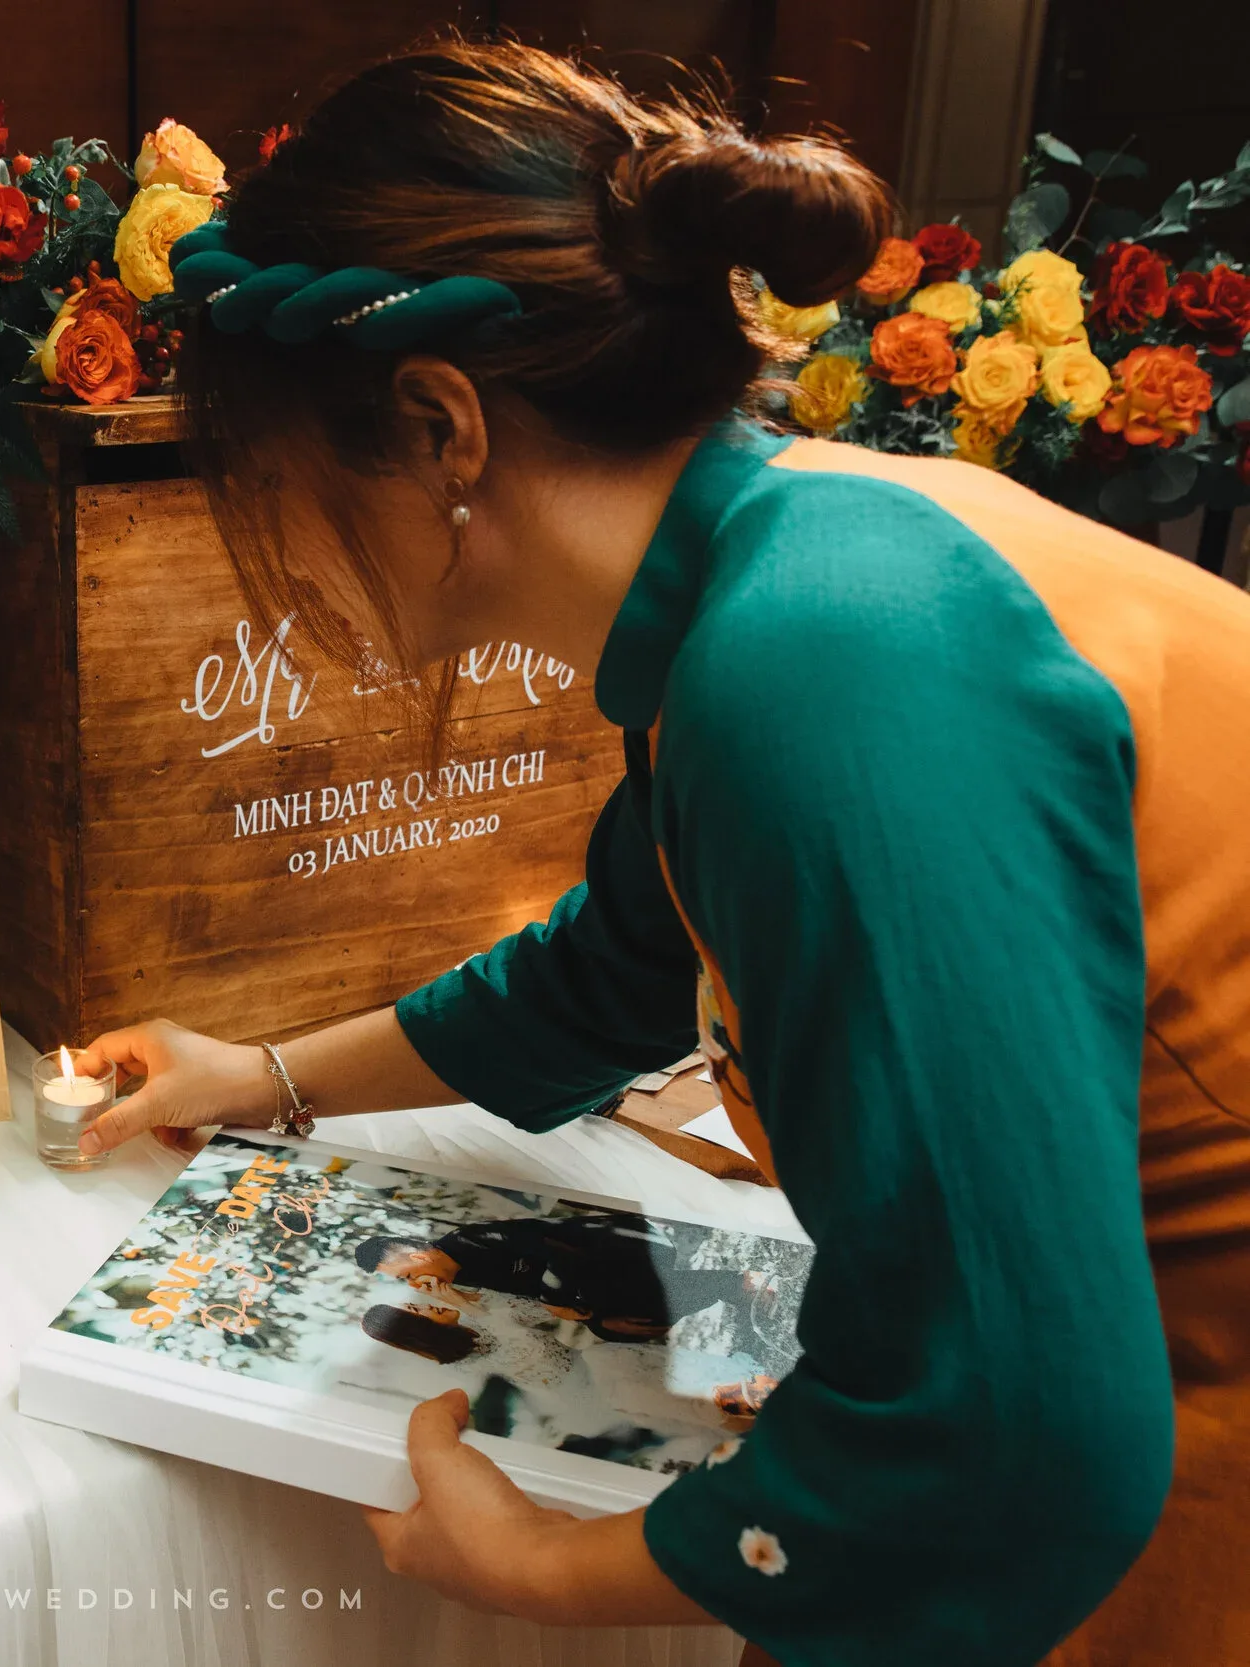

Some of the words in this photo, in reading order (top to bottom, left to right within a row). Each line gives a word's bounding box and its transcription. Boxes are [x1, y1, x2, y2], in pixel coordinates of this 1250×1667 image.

[233, 790, 311, 838] MINH
[319, 779, 374, 825] ĐẠT
[378, 777, 397, 810] &
[501, 749, 546, 788] CHI
[288, 850, 317, 879] 03
[321, 817, 442, 874] JANUARY,
[448, 814, 501, 842] 2020
[130, 1251, 218, 1331] SAVE
[215, 1154, 291, 1220] DATE
[273, 1176, 331, 1237] Chi
